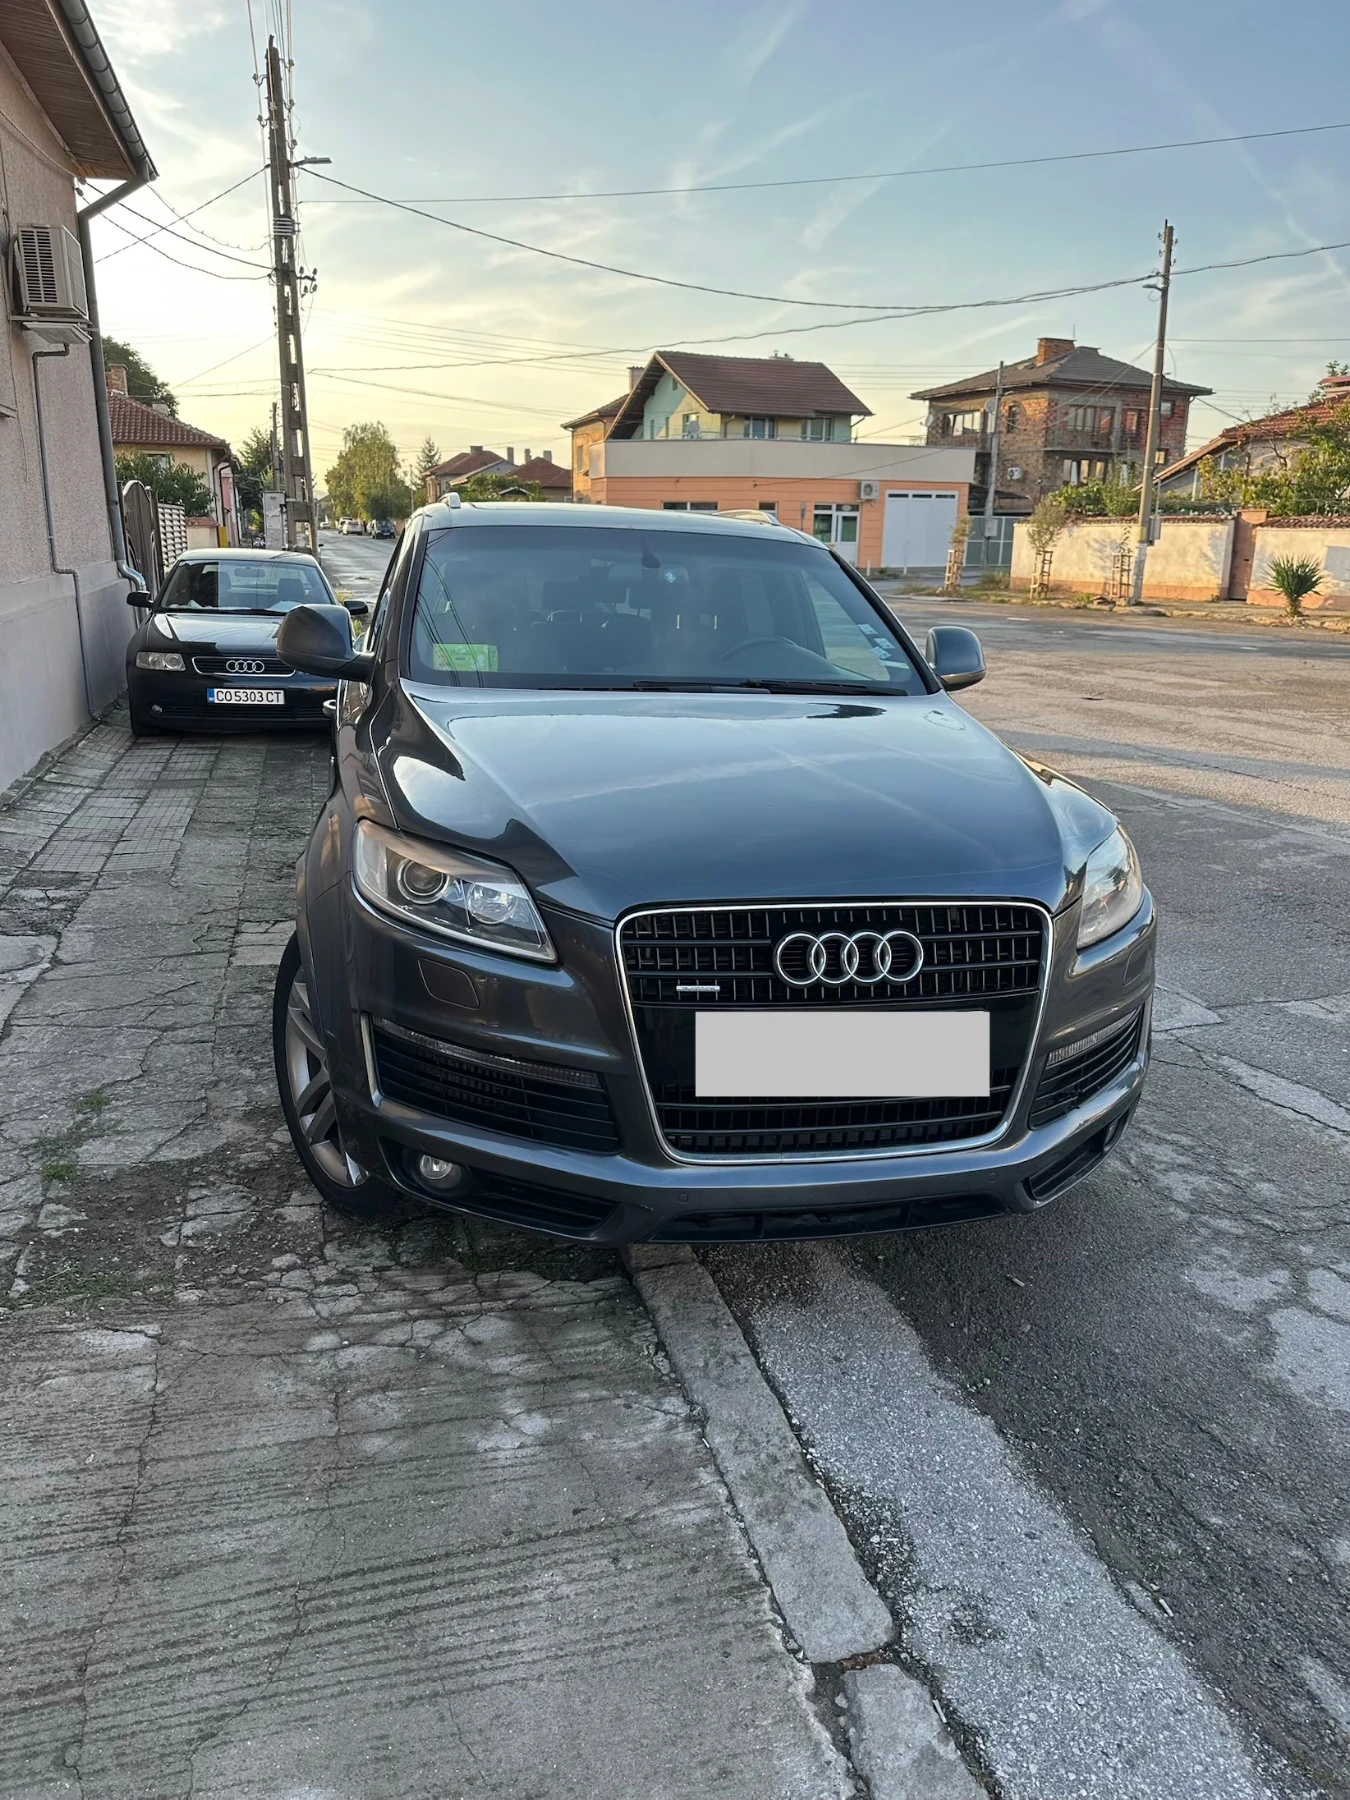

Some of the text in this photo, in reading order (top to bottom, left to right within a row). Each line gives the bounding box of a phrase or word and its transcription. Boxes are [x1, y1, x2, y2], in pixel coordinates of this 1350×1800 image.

[216, 690, 233, 702] CO
[234, 691, 264, 703] 5303
[266, 691, 282, 703] CT
